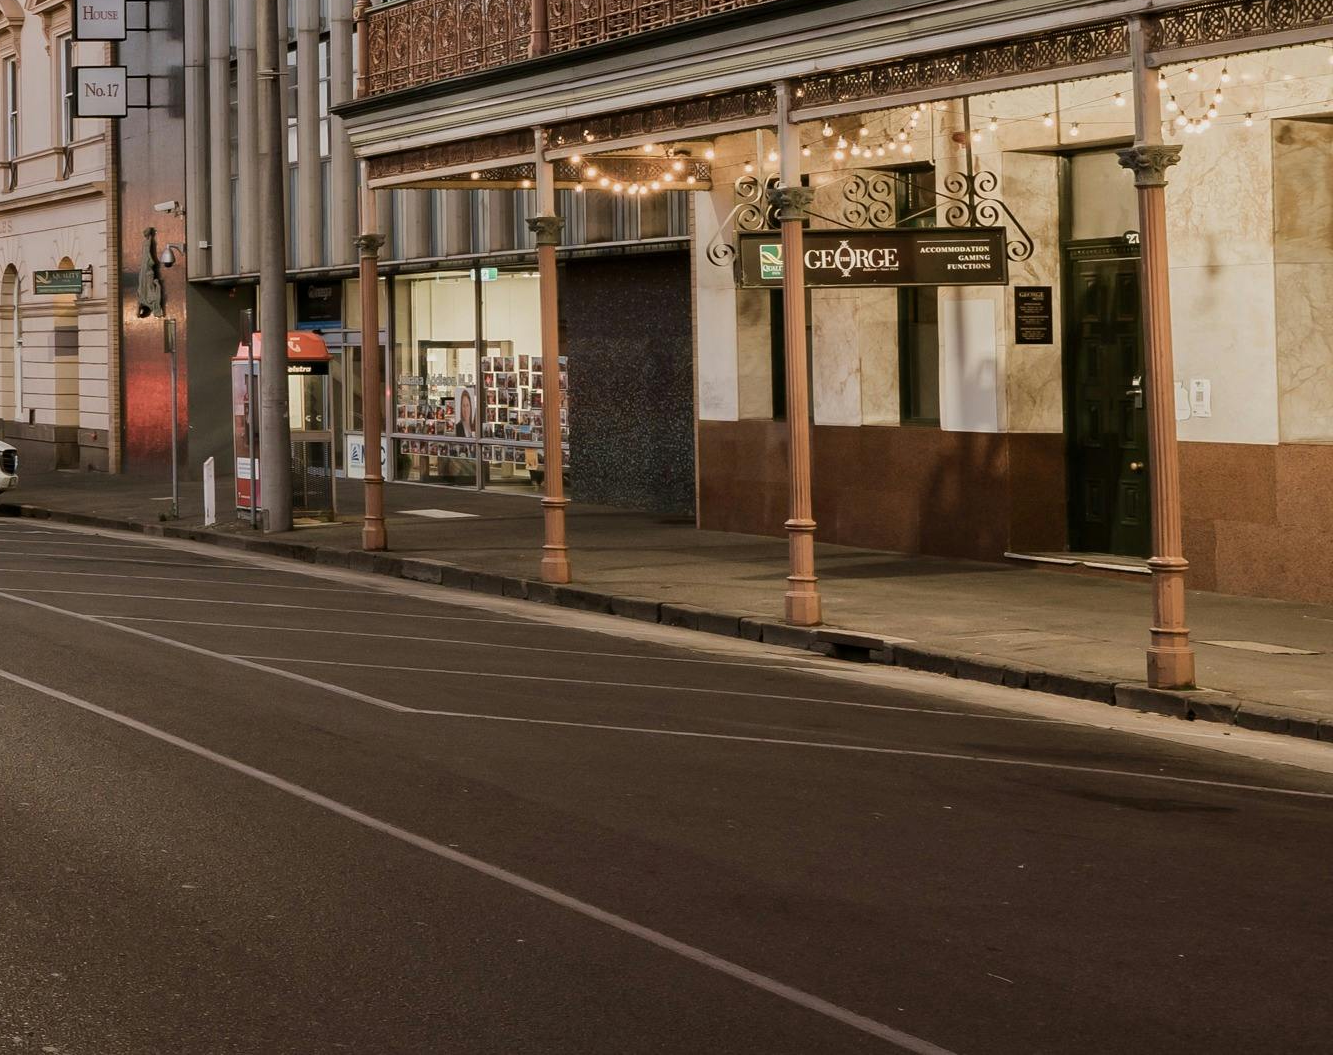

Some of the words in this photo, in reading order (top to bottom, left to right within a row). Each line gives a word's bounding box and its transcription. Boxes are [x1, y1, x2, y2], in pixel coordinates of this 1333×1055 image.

[83, 5, 118, 20] HOUSE
[920, 245, 990, 254] ACCOMMODATION
[804, 247, 899, 270] GEORGE
[958, 254, 991, 262] GAMING
[947, 262, 991, 270] FUNCTIONS
[52, 272, 80, 281] QUALITY
[287, 365, 312, 373] elstra
